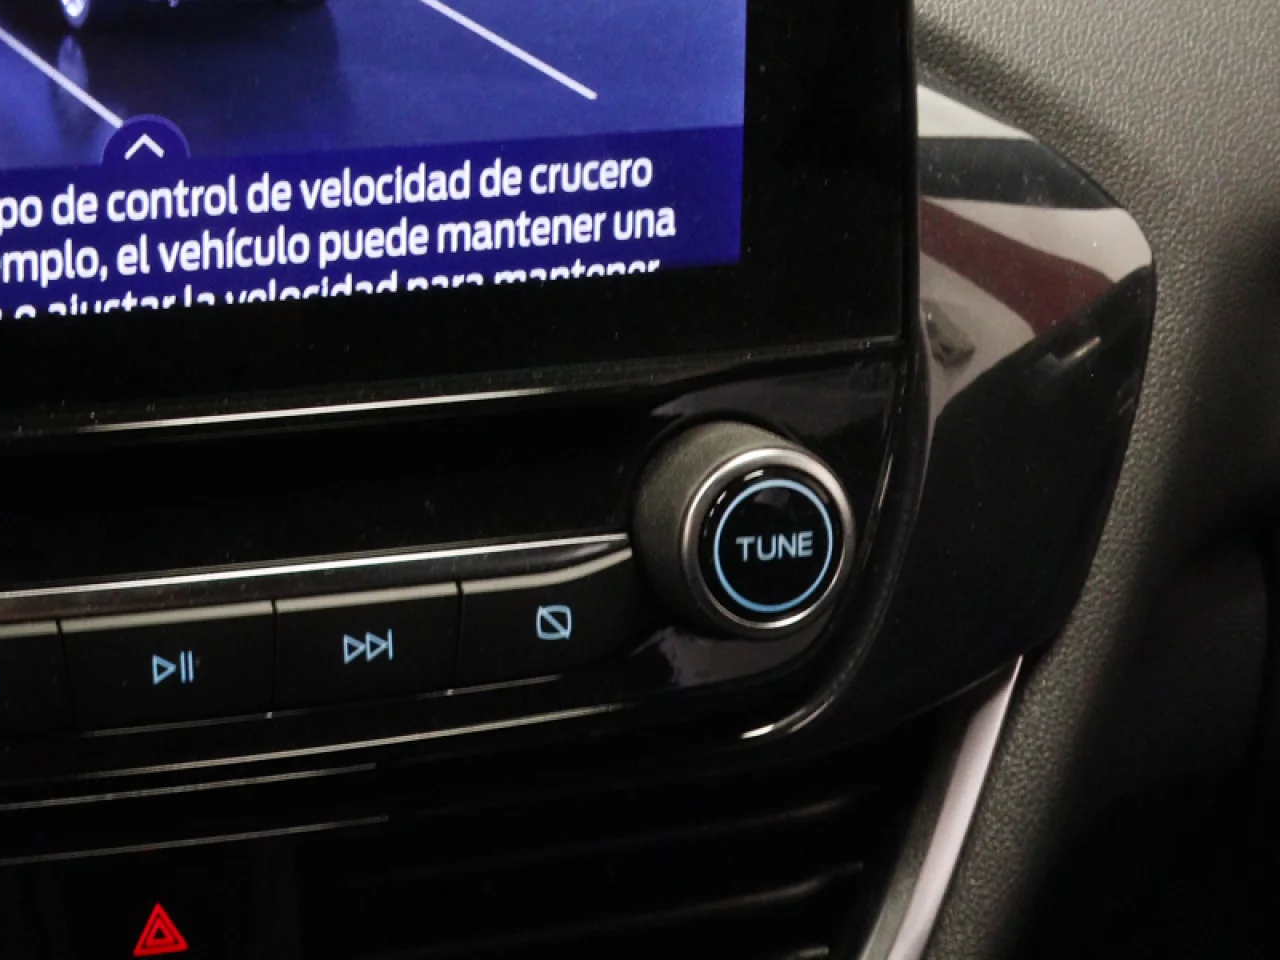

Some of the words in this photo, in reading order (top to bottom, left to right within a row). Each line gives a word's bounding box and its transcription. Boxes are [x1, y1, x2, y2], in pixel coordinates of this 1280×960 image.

[51, 183, 99, 226] de
[106, 173, 239, 222] control
[246, 171, 292, 214] de
[299, 159, 471, 210] velocidad
[479, 157, 523, 198] de
[529, 157, 653, 195] crucero
[116, 233, 151, 276] el
[158, 224, 311, 273] vehículo
[319, 216, 430, 270] puede
[437, 210, 607, 254] mantener
[613, 207, 677, 242] una
[734, 530, 814, 562] TUNE
